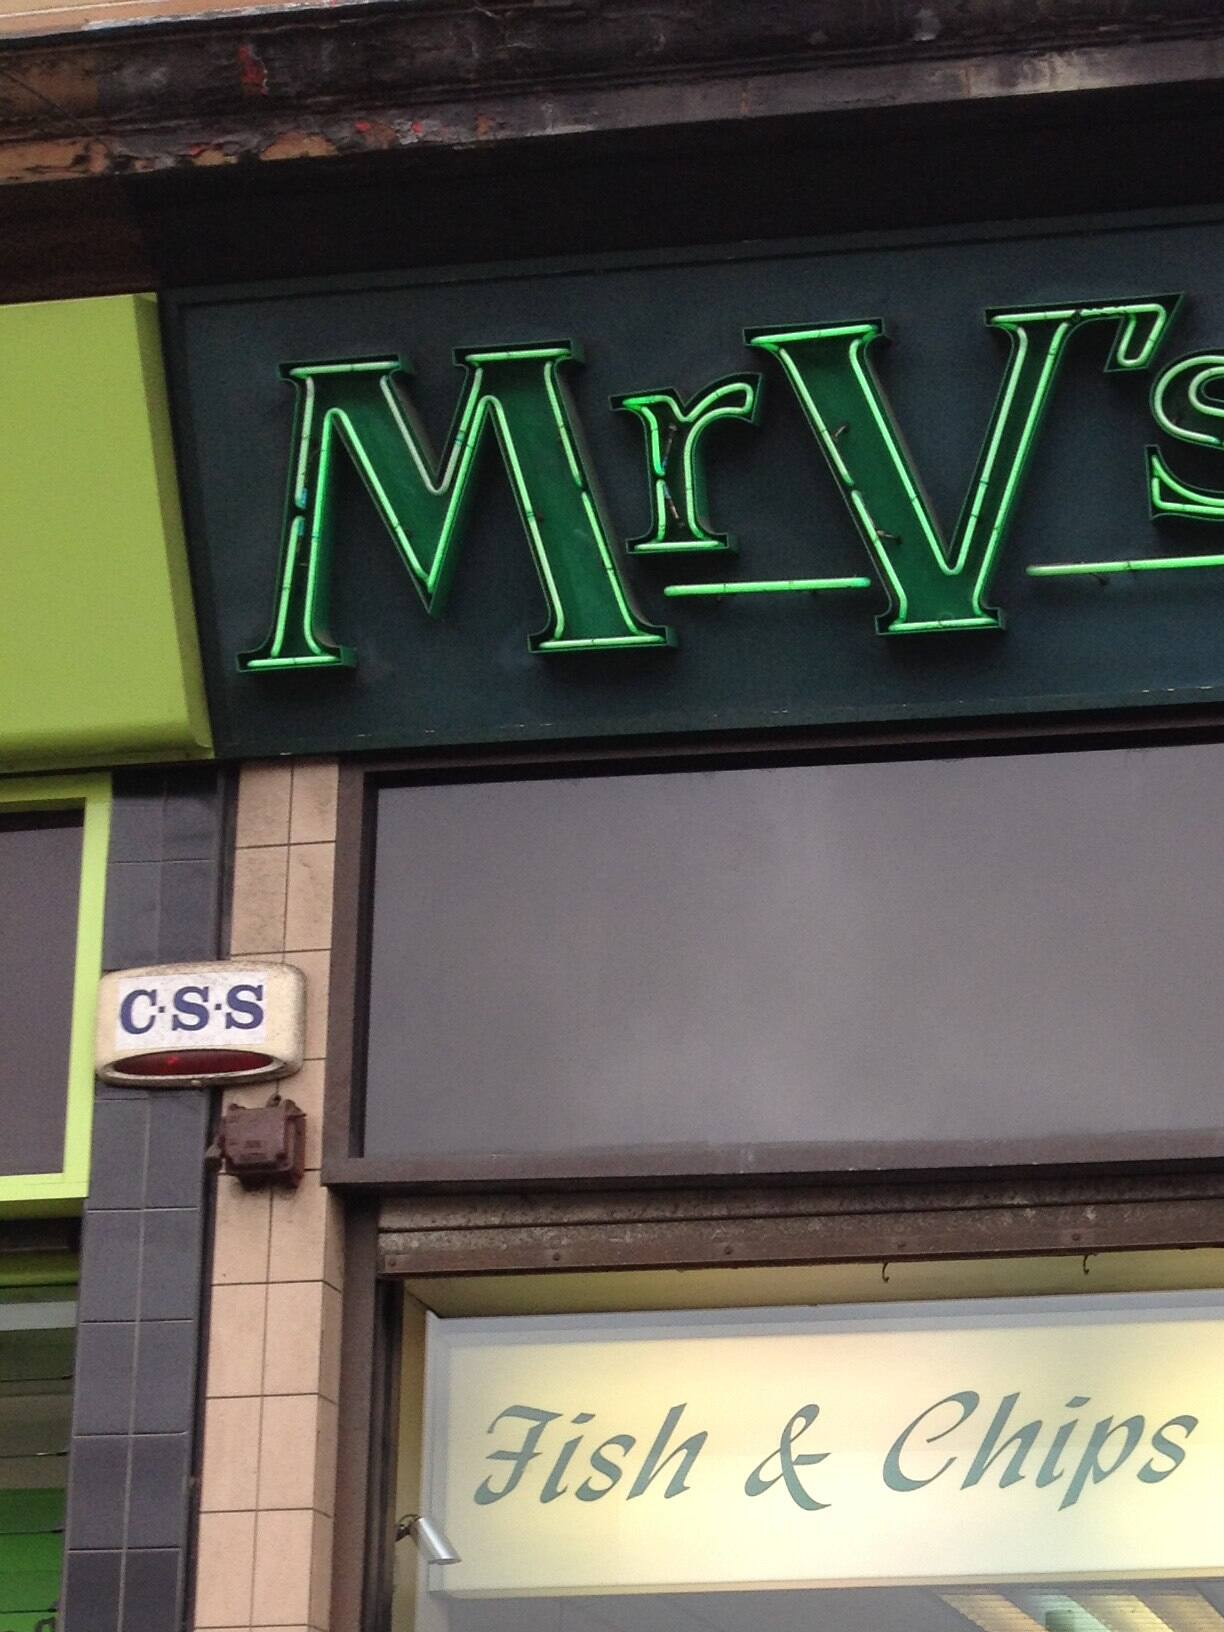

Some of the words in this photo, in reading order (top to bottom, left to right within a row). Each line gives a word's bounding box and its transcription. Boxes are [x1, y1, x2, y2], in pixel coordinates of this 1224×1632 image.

[474, 1402, 708, 1506] Fish
[744, 1403, 832, 1511] &
[882, 1390, 1199, 1512] Chips
